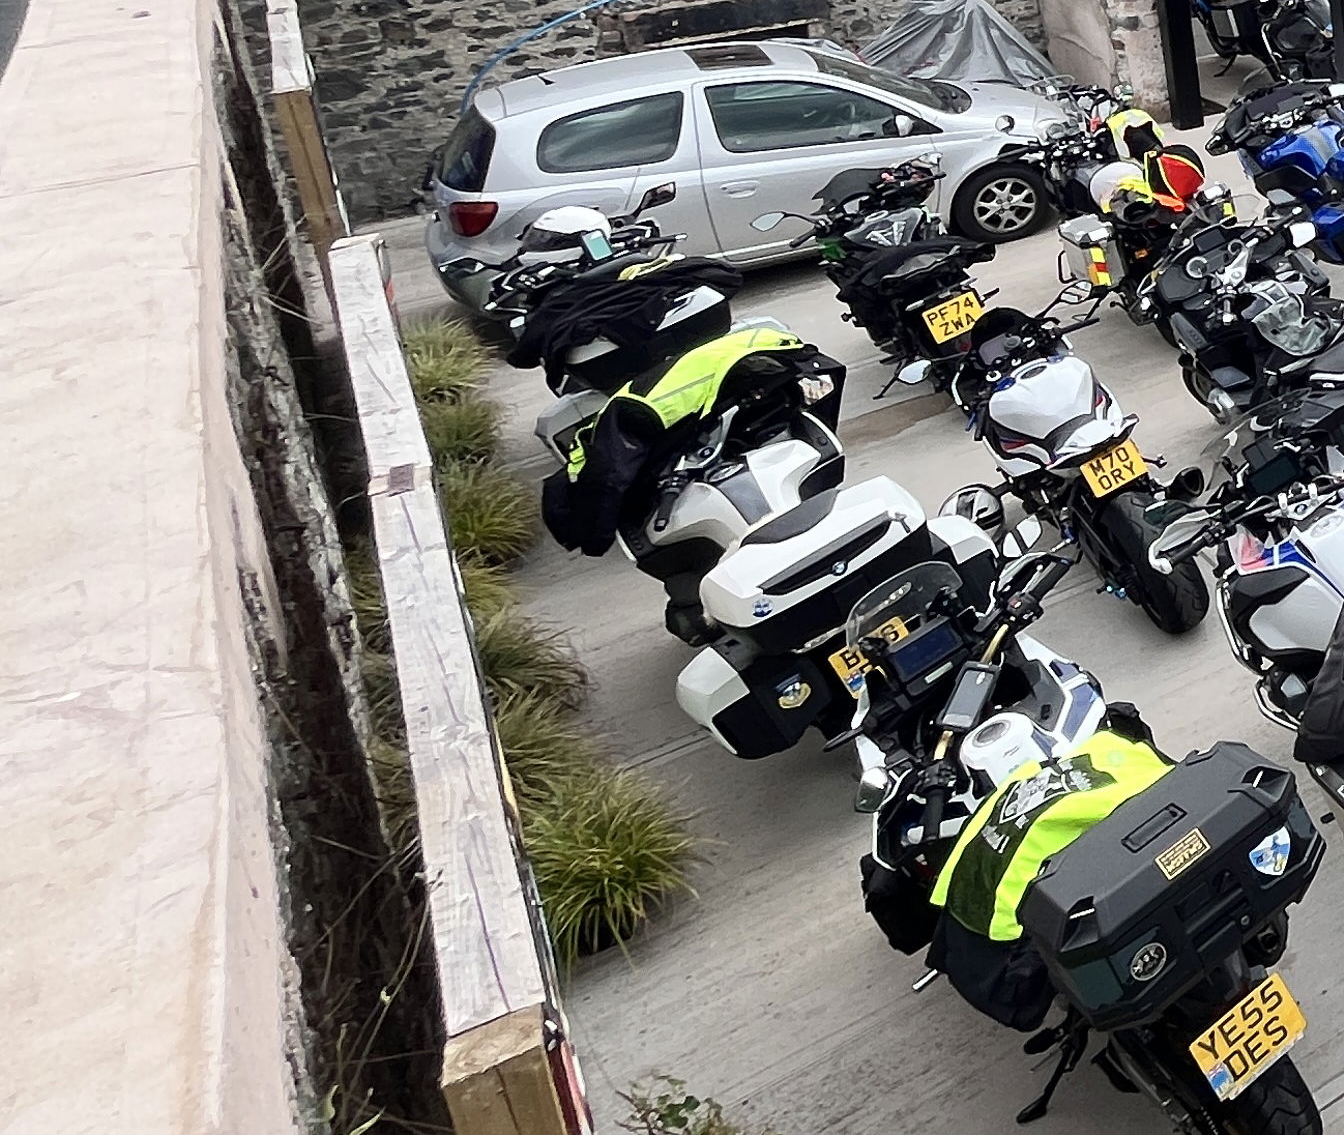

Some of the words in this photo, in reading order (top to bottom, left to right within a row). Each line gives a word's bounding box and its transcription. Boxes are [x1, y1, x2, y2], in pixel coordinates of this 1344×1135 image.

[926, 296, 974, 326] PF74
[938, 313, 976, 336] ZWA
[1088, 446, 1130, 477] M70
[1197, 980, 1283, 1060] YE55
[1222, 1015, 1288, 1082] DES
